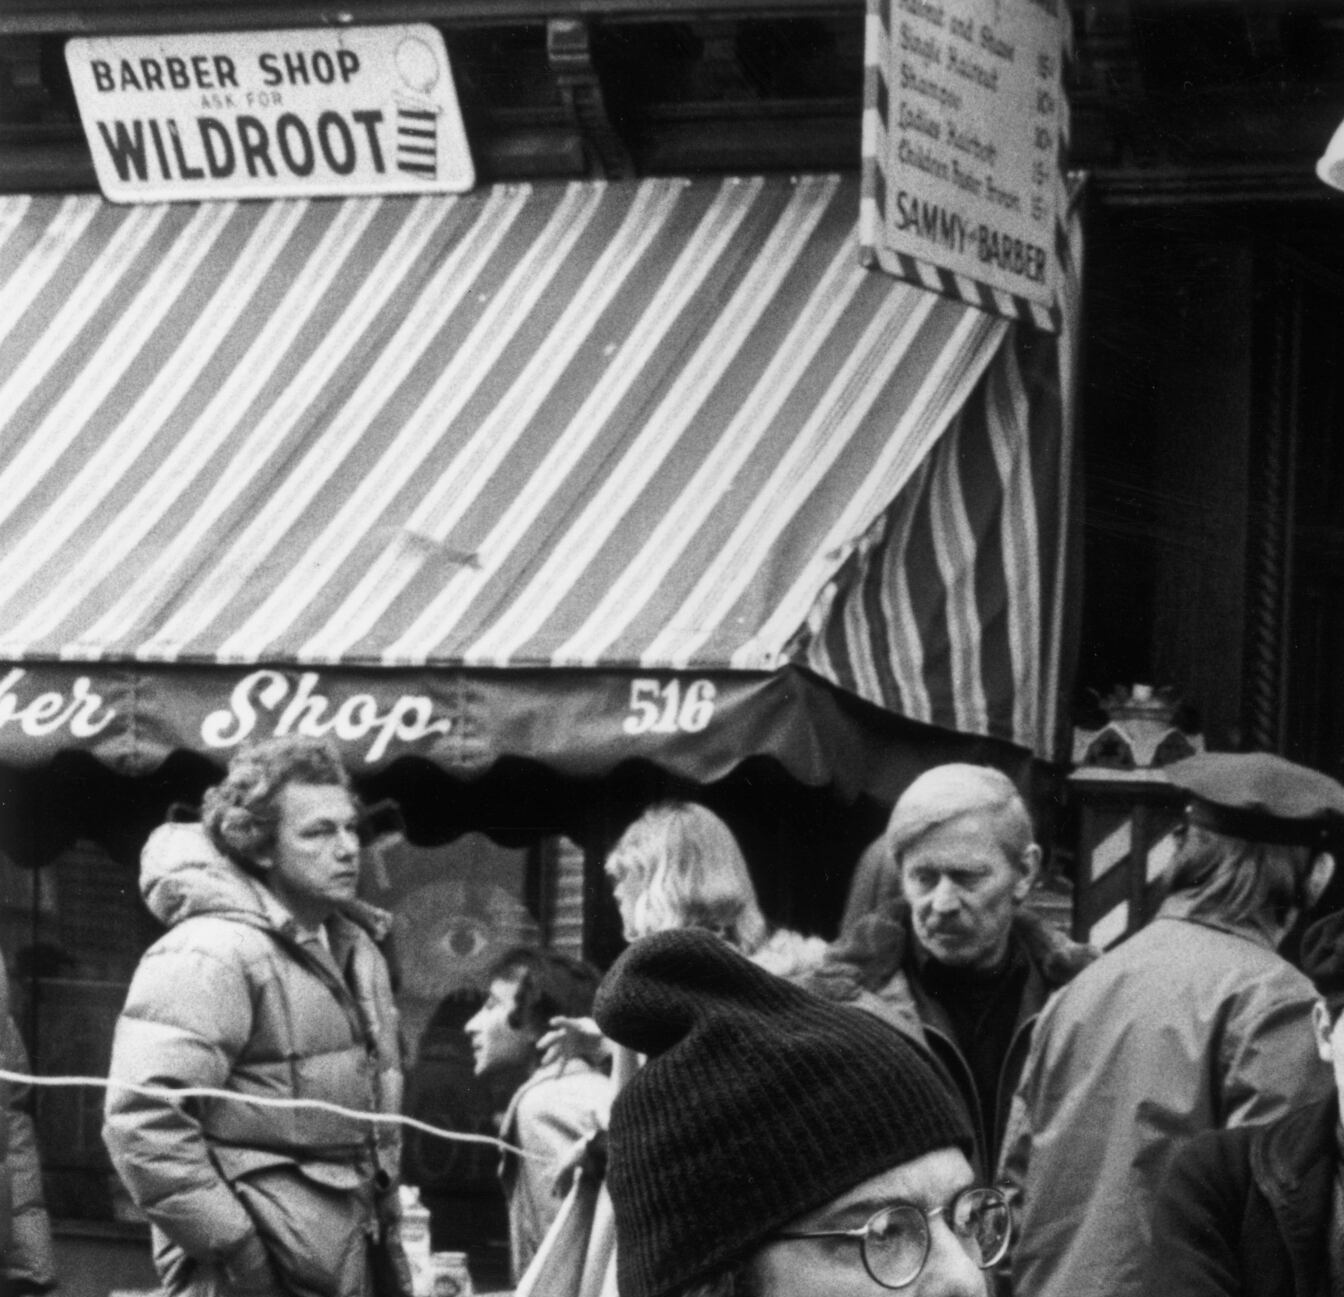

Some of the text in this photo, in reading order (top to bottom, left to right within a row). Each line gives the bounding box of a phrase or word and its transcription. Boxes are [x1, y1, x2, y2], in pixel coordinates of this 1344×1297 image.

[91, 49, 361, 92] BARBER SHOP
[201, 91, 284, 110] ASK FOR
[96, 109, 387, 182] WILDROOT
[895, 189, 965, 255] SAMMY
[978, 224, 1047, 286] BARBER
[201, 669, 452, 763] Shop
[622, 677, 717, 735] 516
